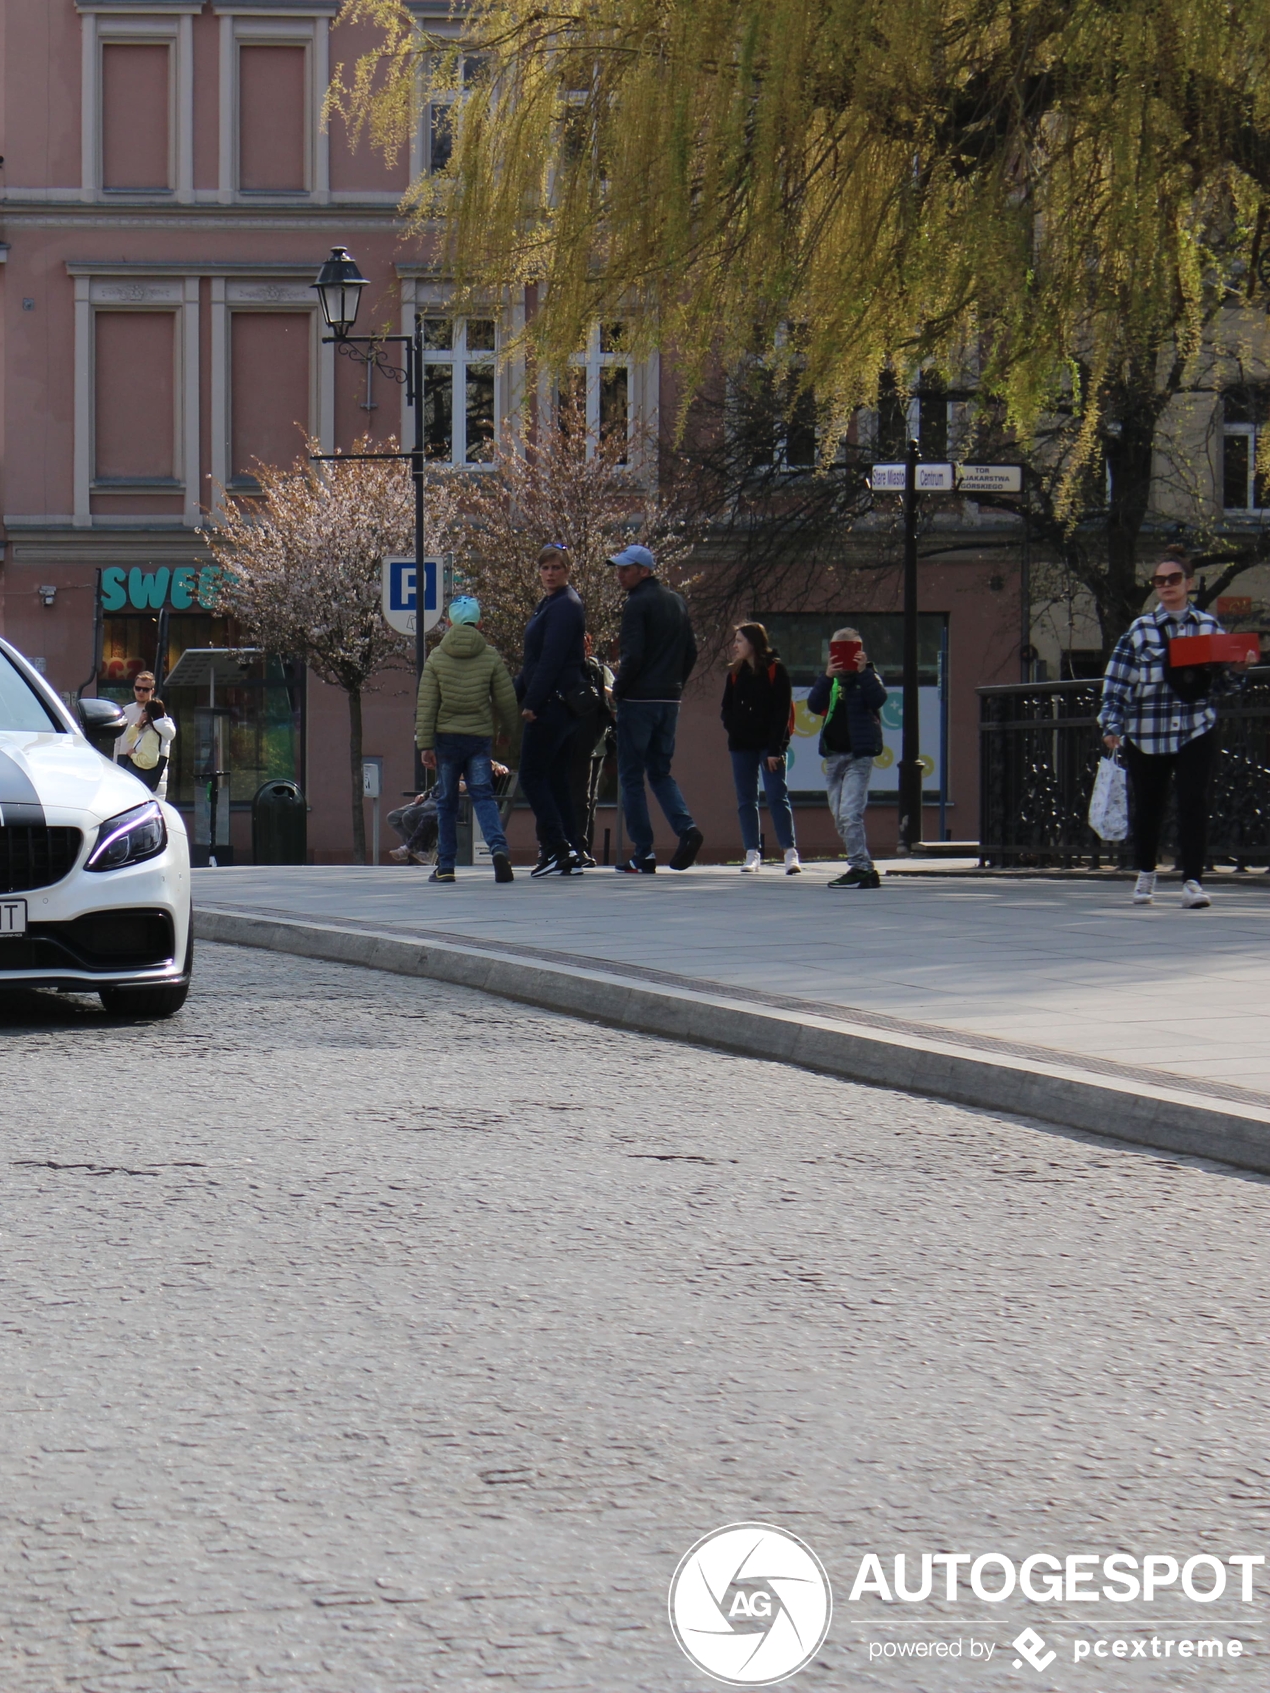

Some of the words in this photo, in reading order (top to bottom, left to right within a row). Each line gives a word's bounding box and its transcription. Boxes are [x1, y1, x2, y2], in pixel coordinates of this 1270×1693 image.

[872, 469, 886, 486] Stare
[887, 469, 905, 486] Miasto
[919, 469, 944, 486] Centrum
